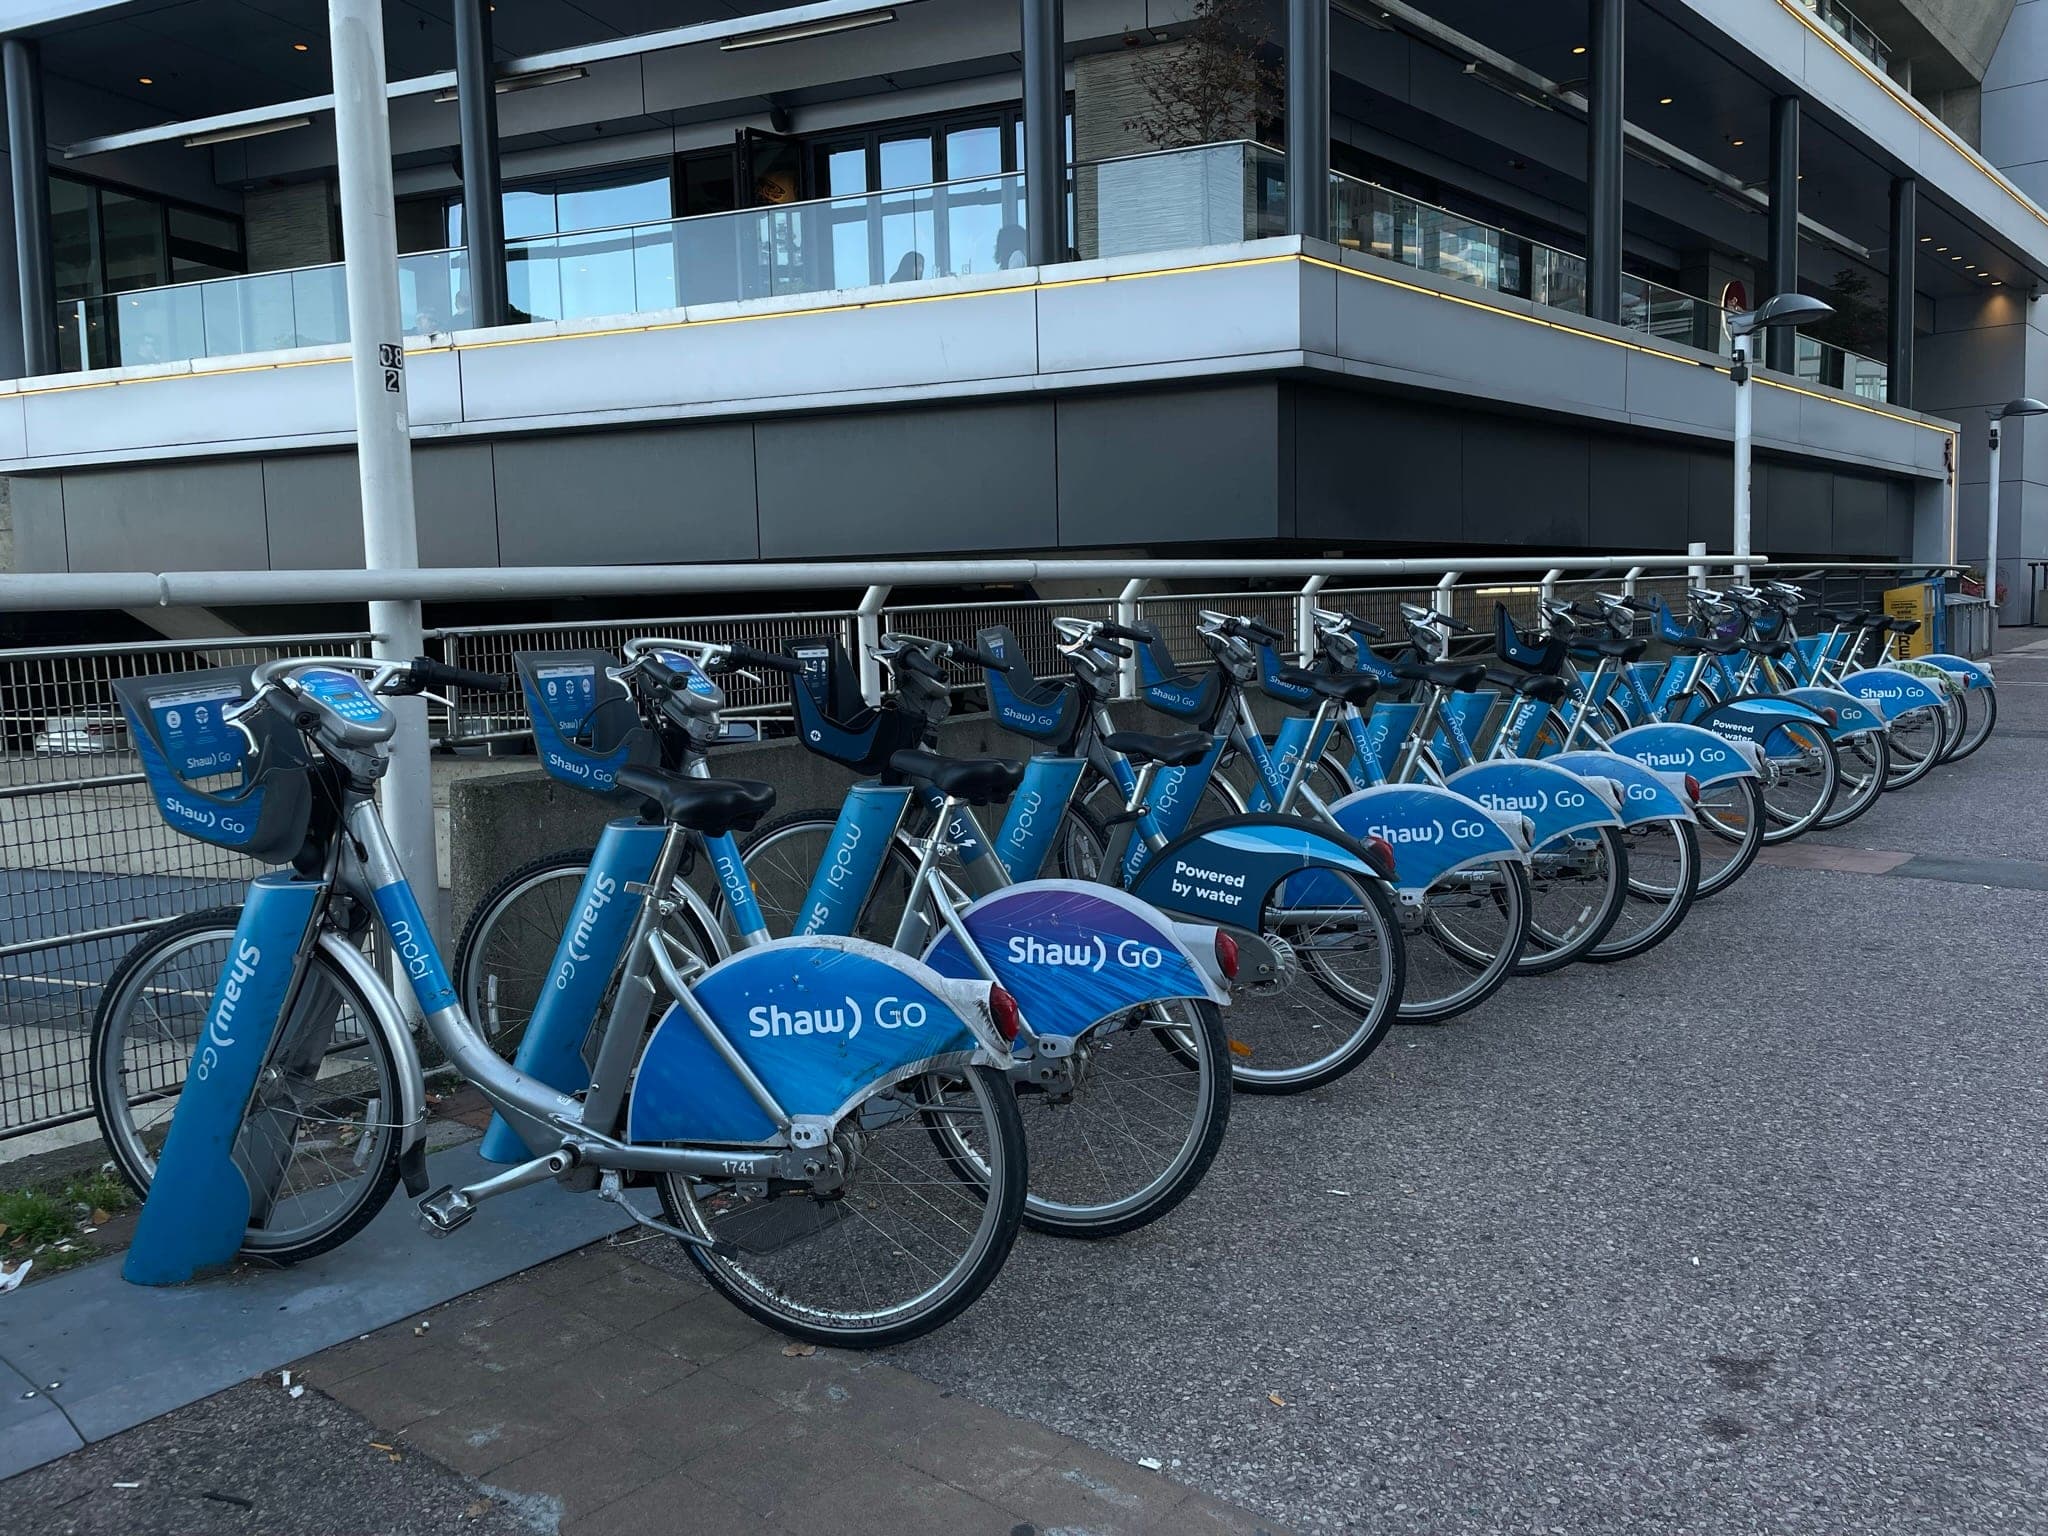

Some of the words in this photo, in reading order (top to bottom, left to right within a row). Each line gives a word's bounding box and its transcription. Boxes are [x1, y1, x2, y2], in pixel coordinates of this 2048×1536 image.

[380, 345, 403, 368] 08
[386, 371, 398, 391] 2
[1906, 687, 1924, 698] Go
[1038, 715, 1053, 726] Go
[1841, 708, 1862, 720] Go
[1712, 719, 1754, 733] Powered
[218, 752, 231, 762] Go
[1356, 734, 1375, 765] mobi
[1700, 747, 1726, 763] Go
[593, 768, 613, 784] Go
[1258, 754, 1279, 787] mobi
[1554, 790, 1585, 808] Go
[1627, 783, 1657, 801] Go
[220, 817, 245, 835] Go
[1010, 791, 1042, 850] mobi
[1451, 819, 1485, 839] Go
[827, 823, 862, 890] mobi
[717, 856, 752, 907] mobi
[1175, 860, 1246, 888] Powered
[1172, 879, 1194, 898] by
[1195, 886, 1243, 906] water
[391, 920, 434, 981] mobi
[1117, 939, 1163, 969] Go
[556, 960, 576, 990] Go
[874, 996, 927, 1029] Go
[197, 1046, 218, 1081] Go
[721, 1159, 755, 1175] 1741
